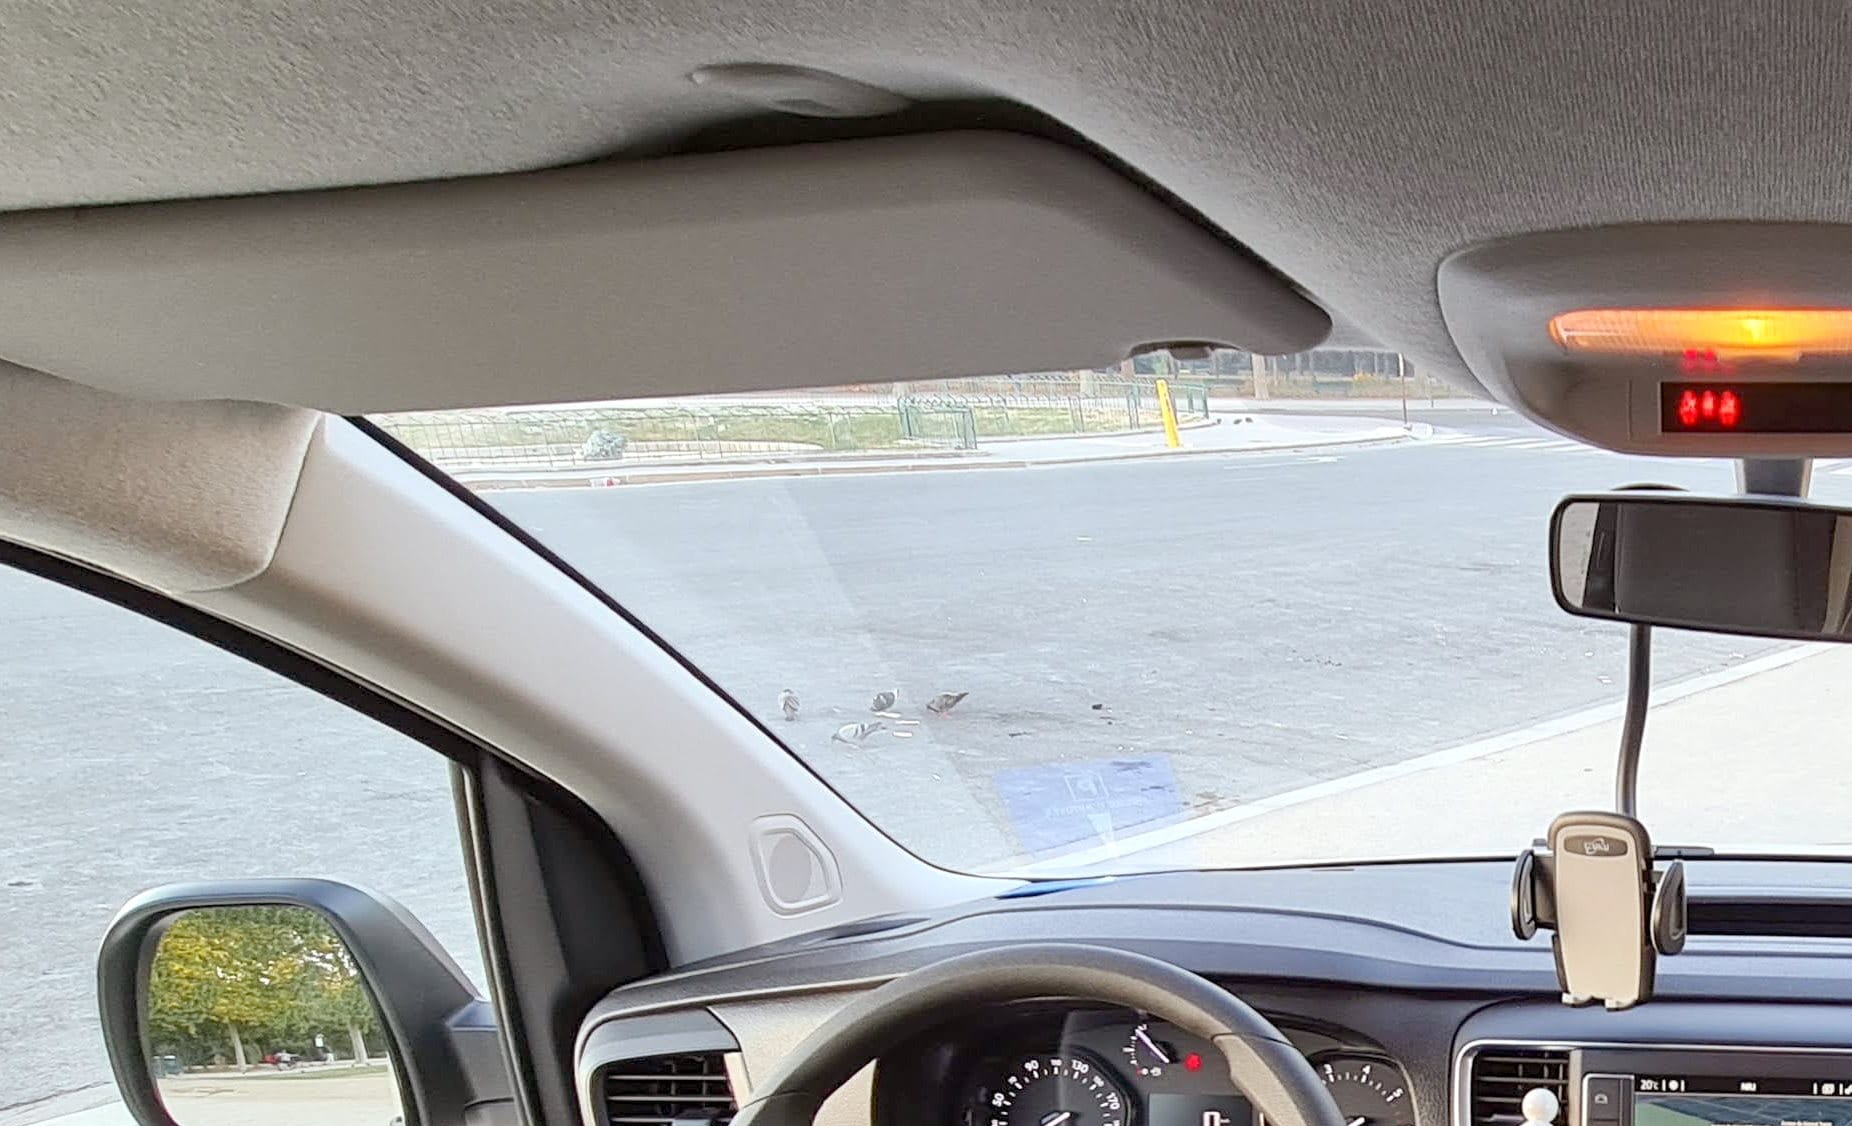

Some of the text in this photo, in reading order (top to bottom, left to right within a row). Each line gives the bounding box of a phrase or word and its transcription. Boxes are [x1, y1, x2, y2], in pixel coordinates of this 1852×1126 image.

[1024, 1060, 1039, 1071] 90
[1072, 1060, 1089, 1073] 130
[1363, 1065, 1371, 1074] 4
[992, 1093, 1004, 1107] 50
[1106, 1092, 1120, 1109] 170
